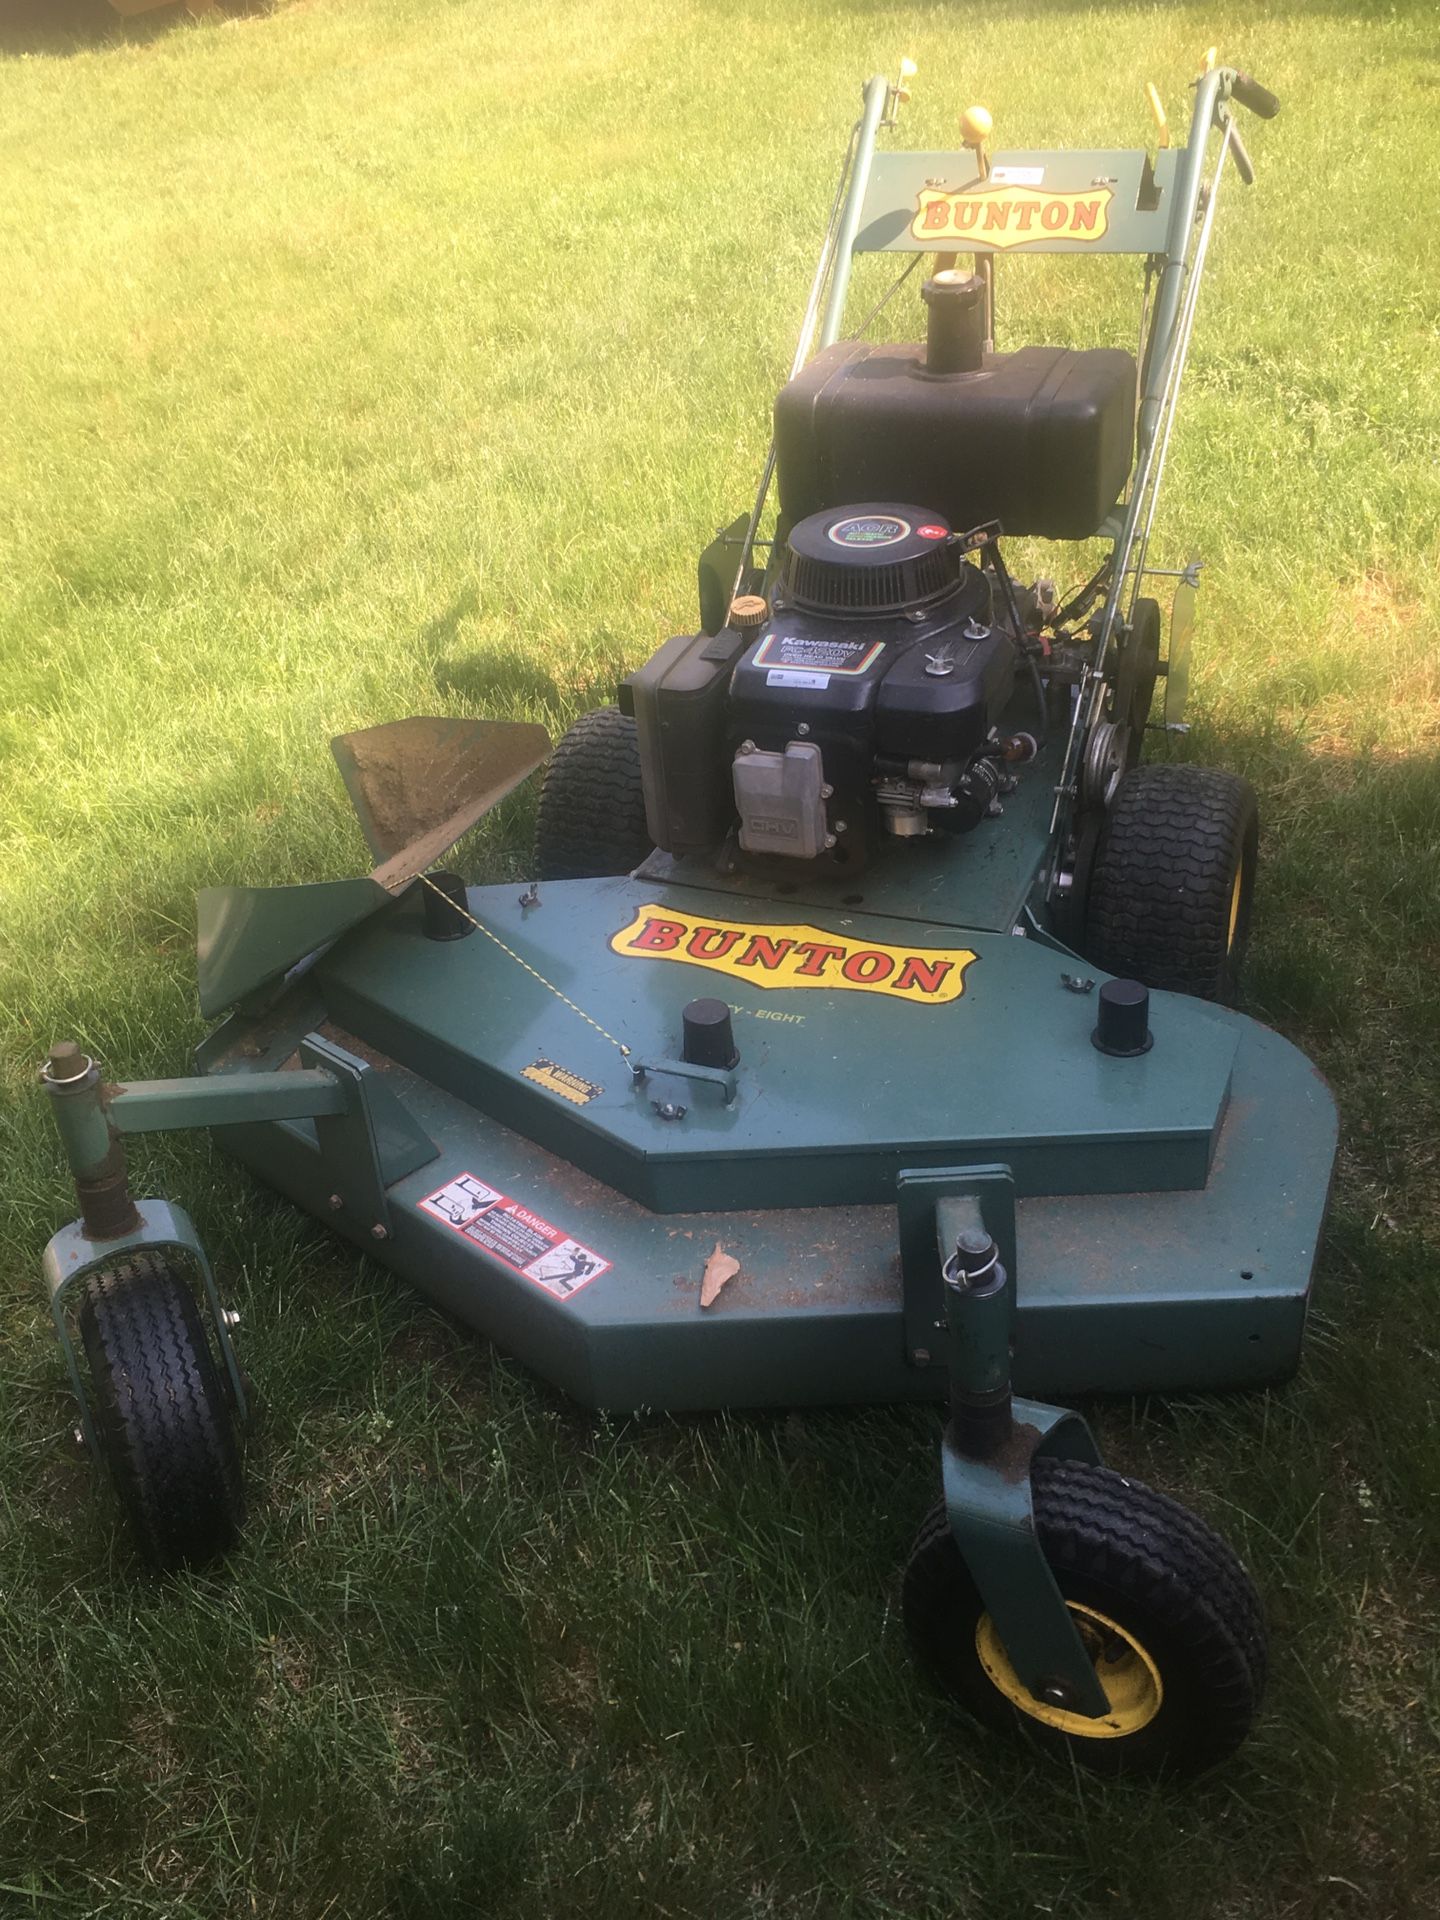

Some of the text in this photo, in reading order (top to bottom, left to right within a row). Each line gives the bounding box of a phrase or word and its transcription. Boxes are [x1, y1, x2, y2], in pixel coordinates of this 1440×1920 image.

[922, 200, 1101, 231] BUNTON
[781, 637, 866, 651] Kawasaki
[628, 918, 954, 993] BUNTON
[755, 1009, 806, 1024] EIGHT
[553, 1070, 591, 1093] WARNING
[516, 1210, 558, 1238] DANGER
